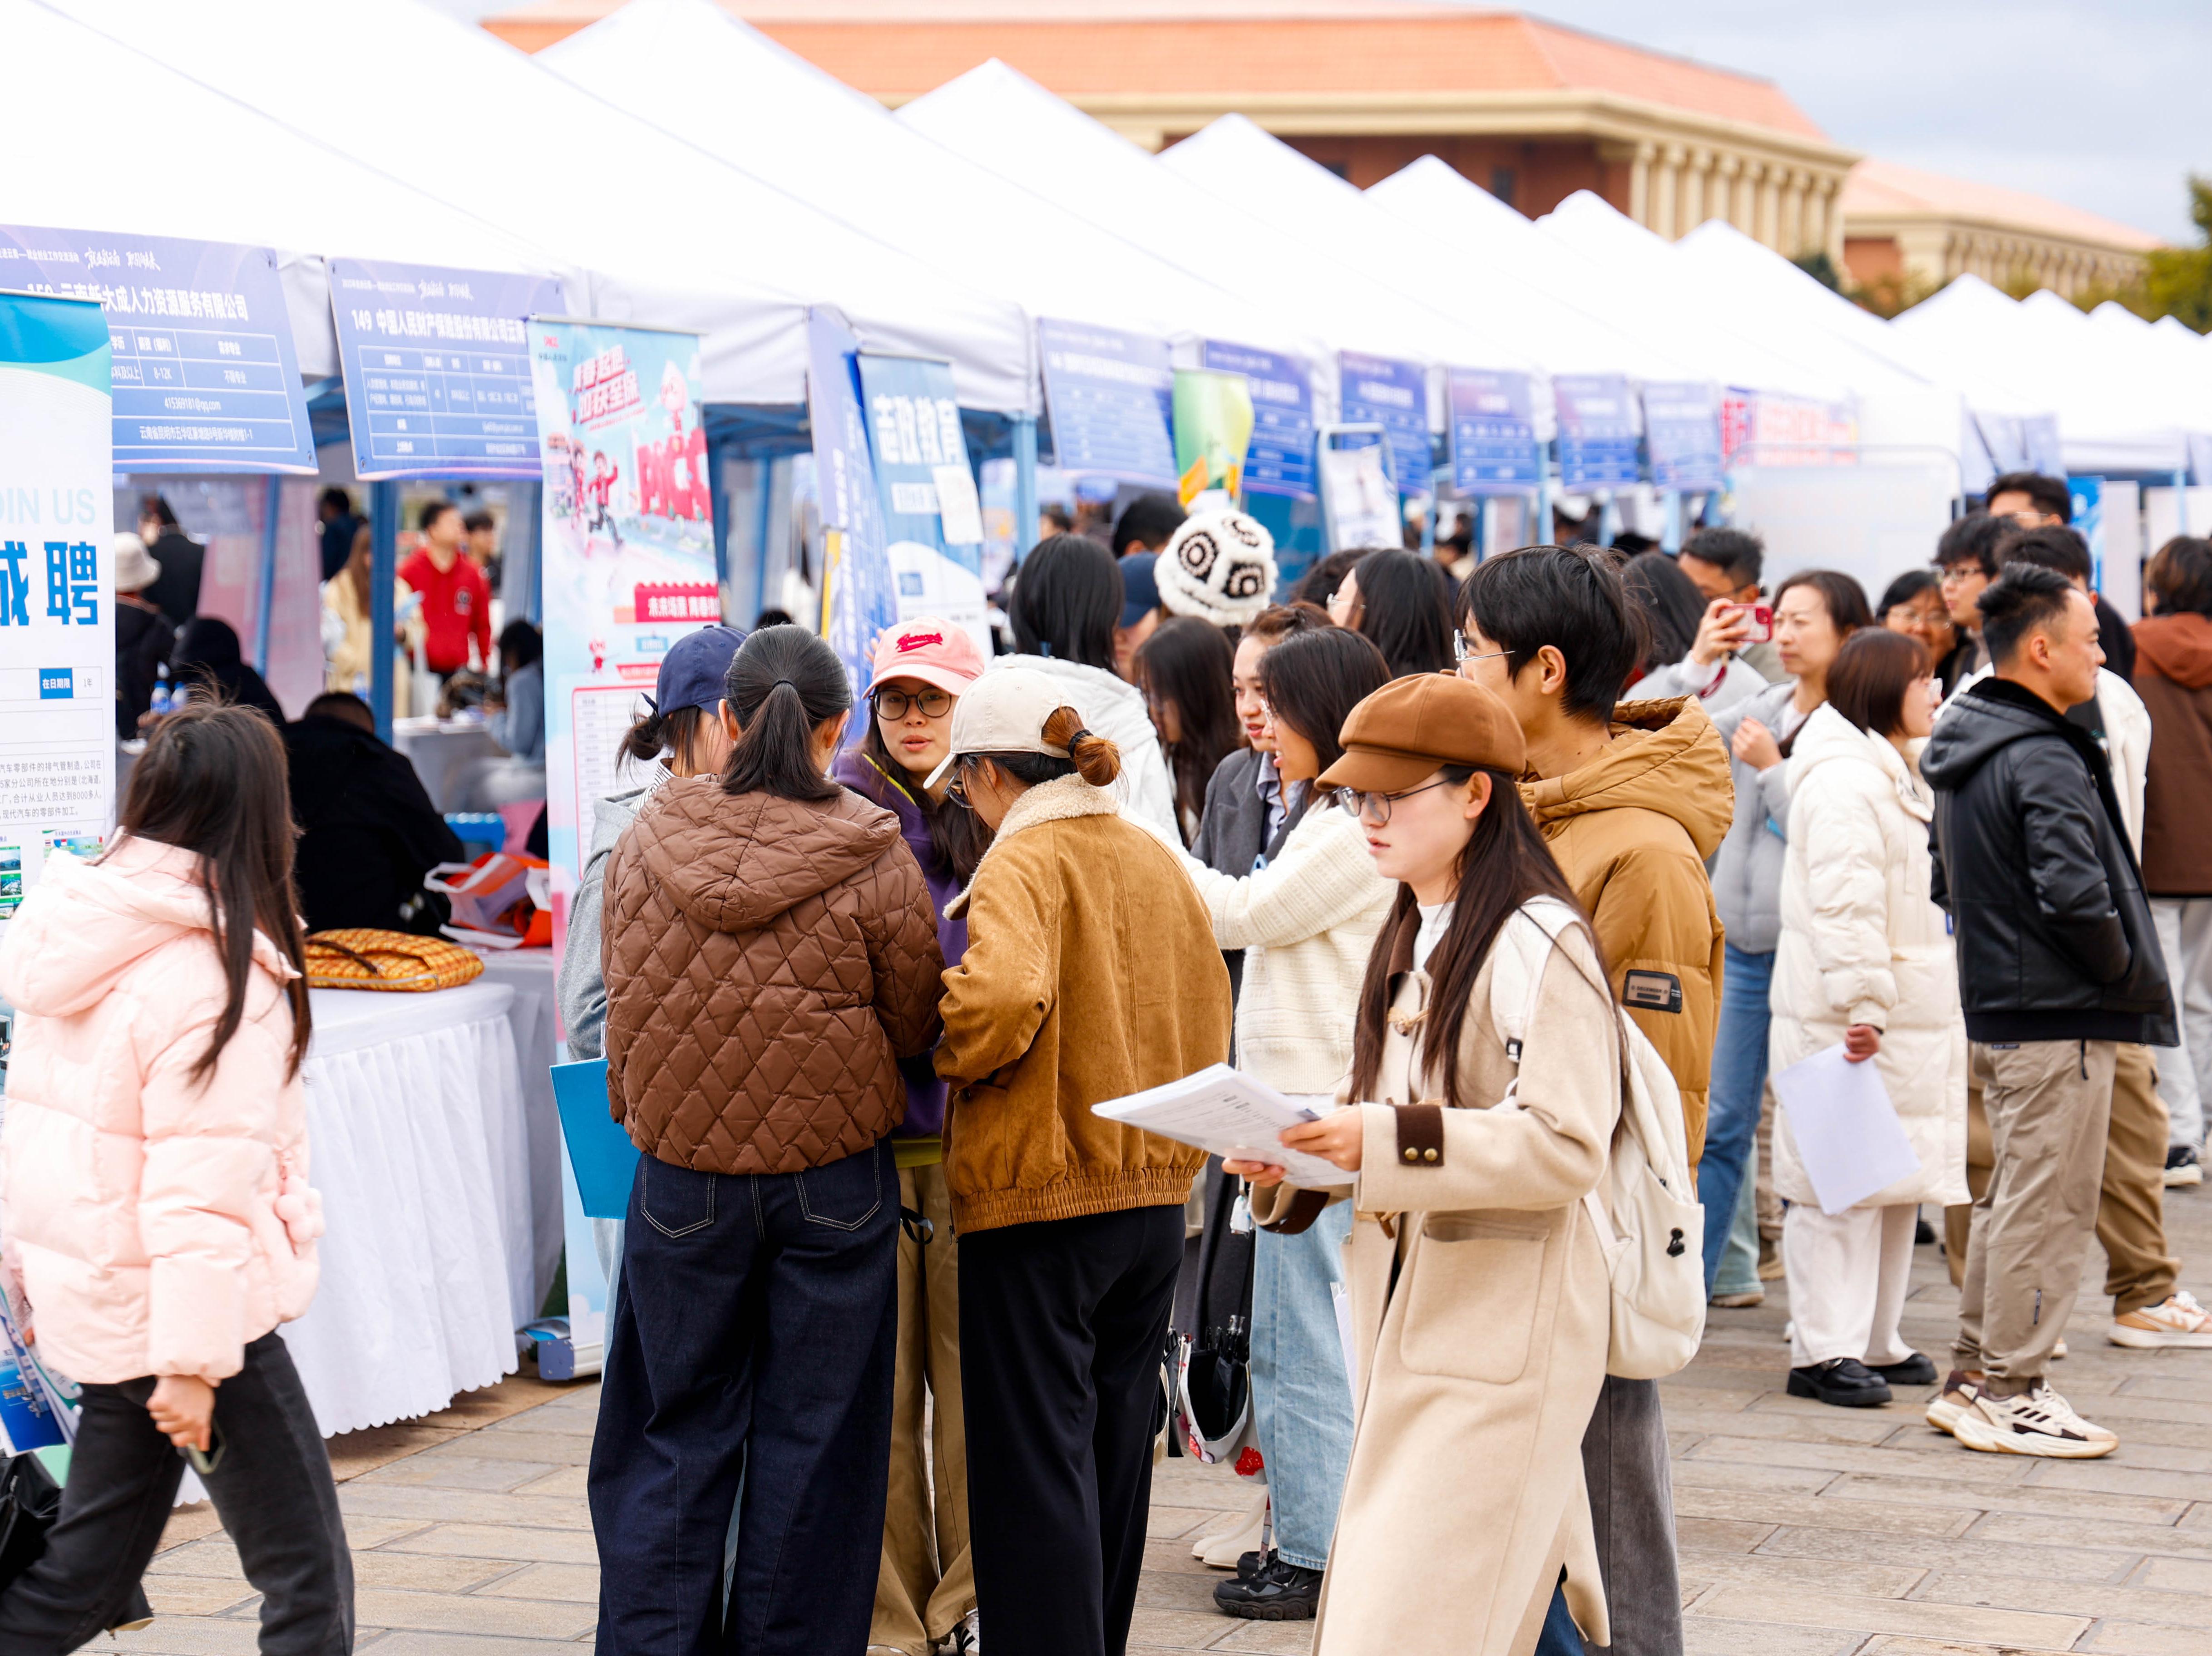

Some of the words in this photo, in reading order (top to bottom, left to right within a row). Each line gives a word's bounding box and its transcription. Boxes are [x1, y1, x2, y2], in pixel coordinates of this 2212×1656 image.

[351, 309, 372, 331] 149
[0, 488, 40, 524] IN
[53, 488, 95, 525] US
